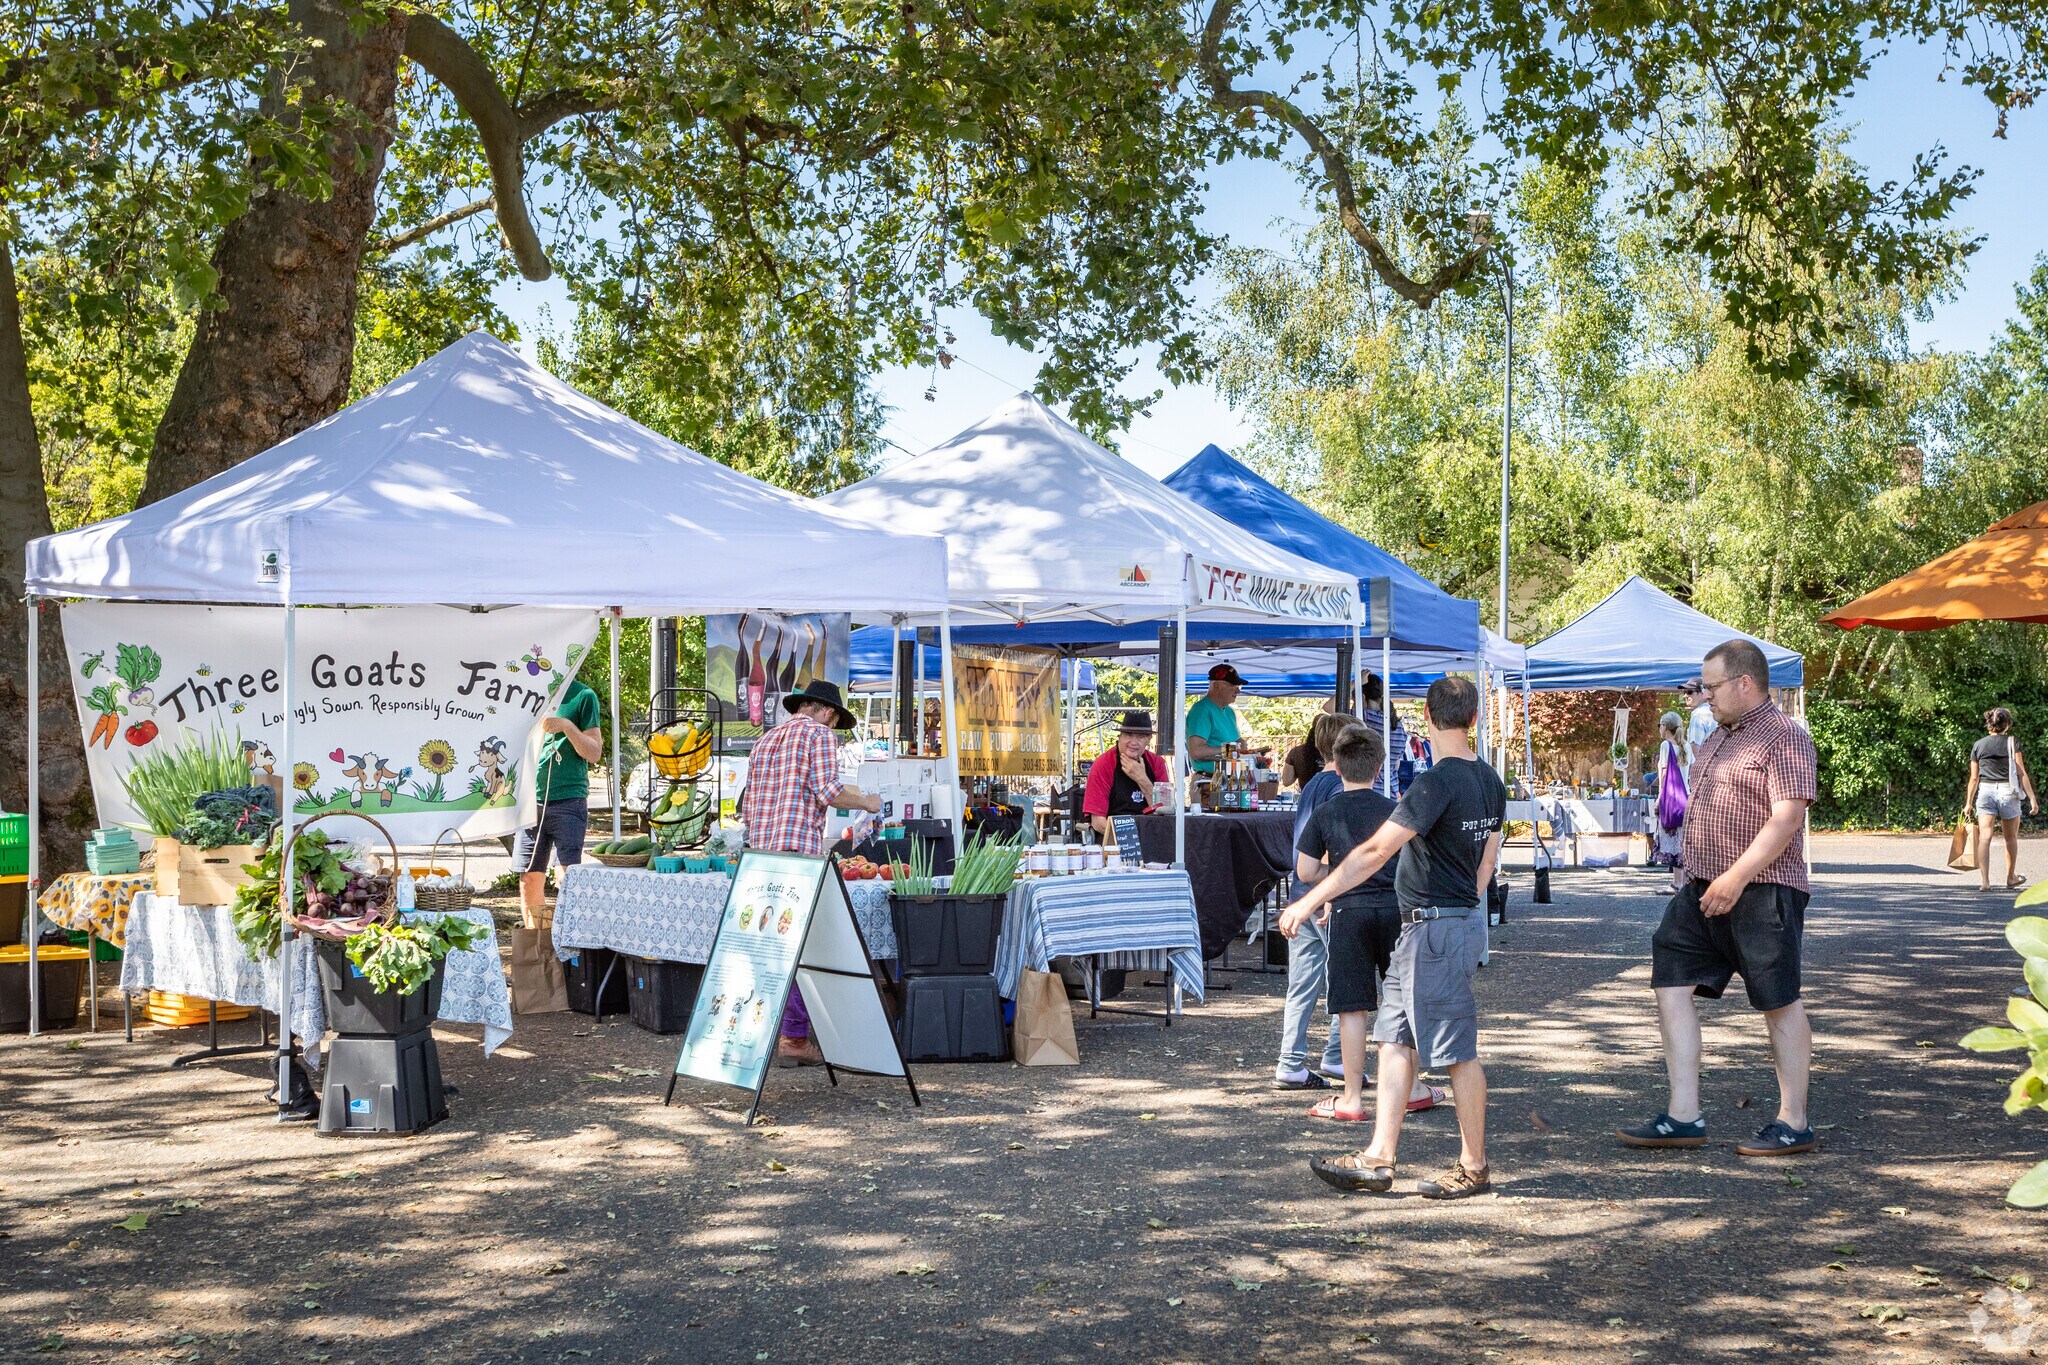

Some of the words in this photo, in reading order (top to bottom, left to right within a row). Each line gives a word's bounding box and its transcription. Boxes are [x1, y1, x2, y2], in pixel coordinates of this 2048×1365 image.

[1250, 575, 1294, 614] WINE
[1295, 583, 1353, 621] TASTING
[159, 668, 280, 723] Three
[311, 650, 427, 688] Goats
[457, 660, 546, 717] Farm
[966, 665, 1041, 728] HONEY
[262, 701, 318, 727] Lovgly
[369, 693, 441, 720] Responsibly
[445, 700, 485, 722] Grown
[960, 730, 982, 751] RAW
[989, 731, 1013, 752] PURE
[1020, 733, 1048, 753] LOCAL
[1461, 820, 1478, 831] PUT
